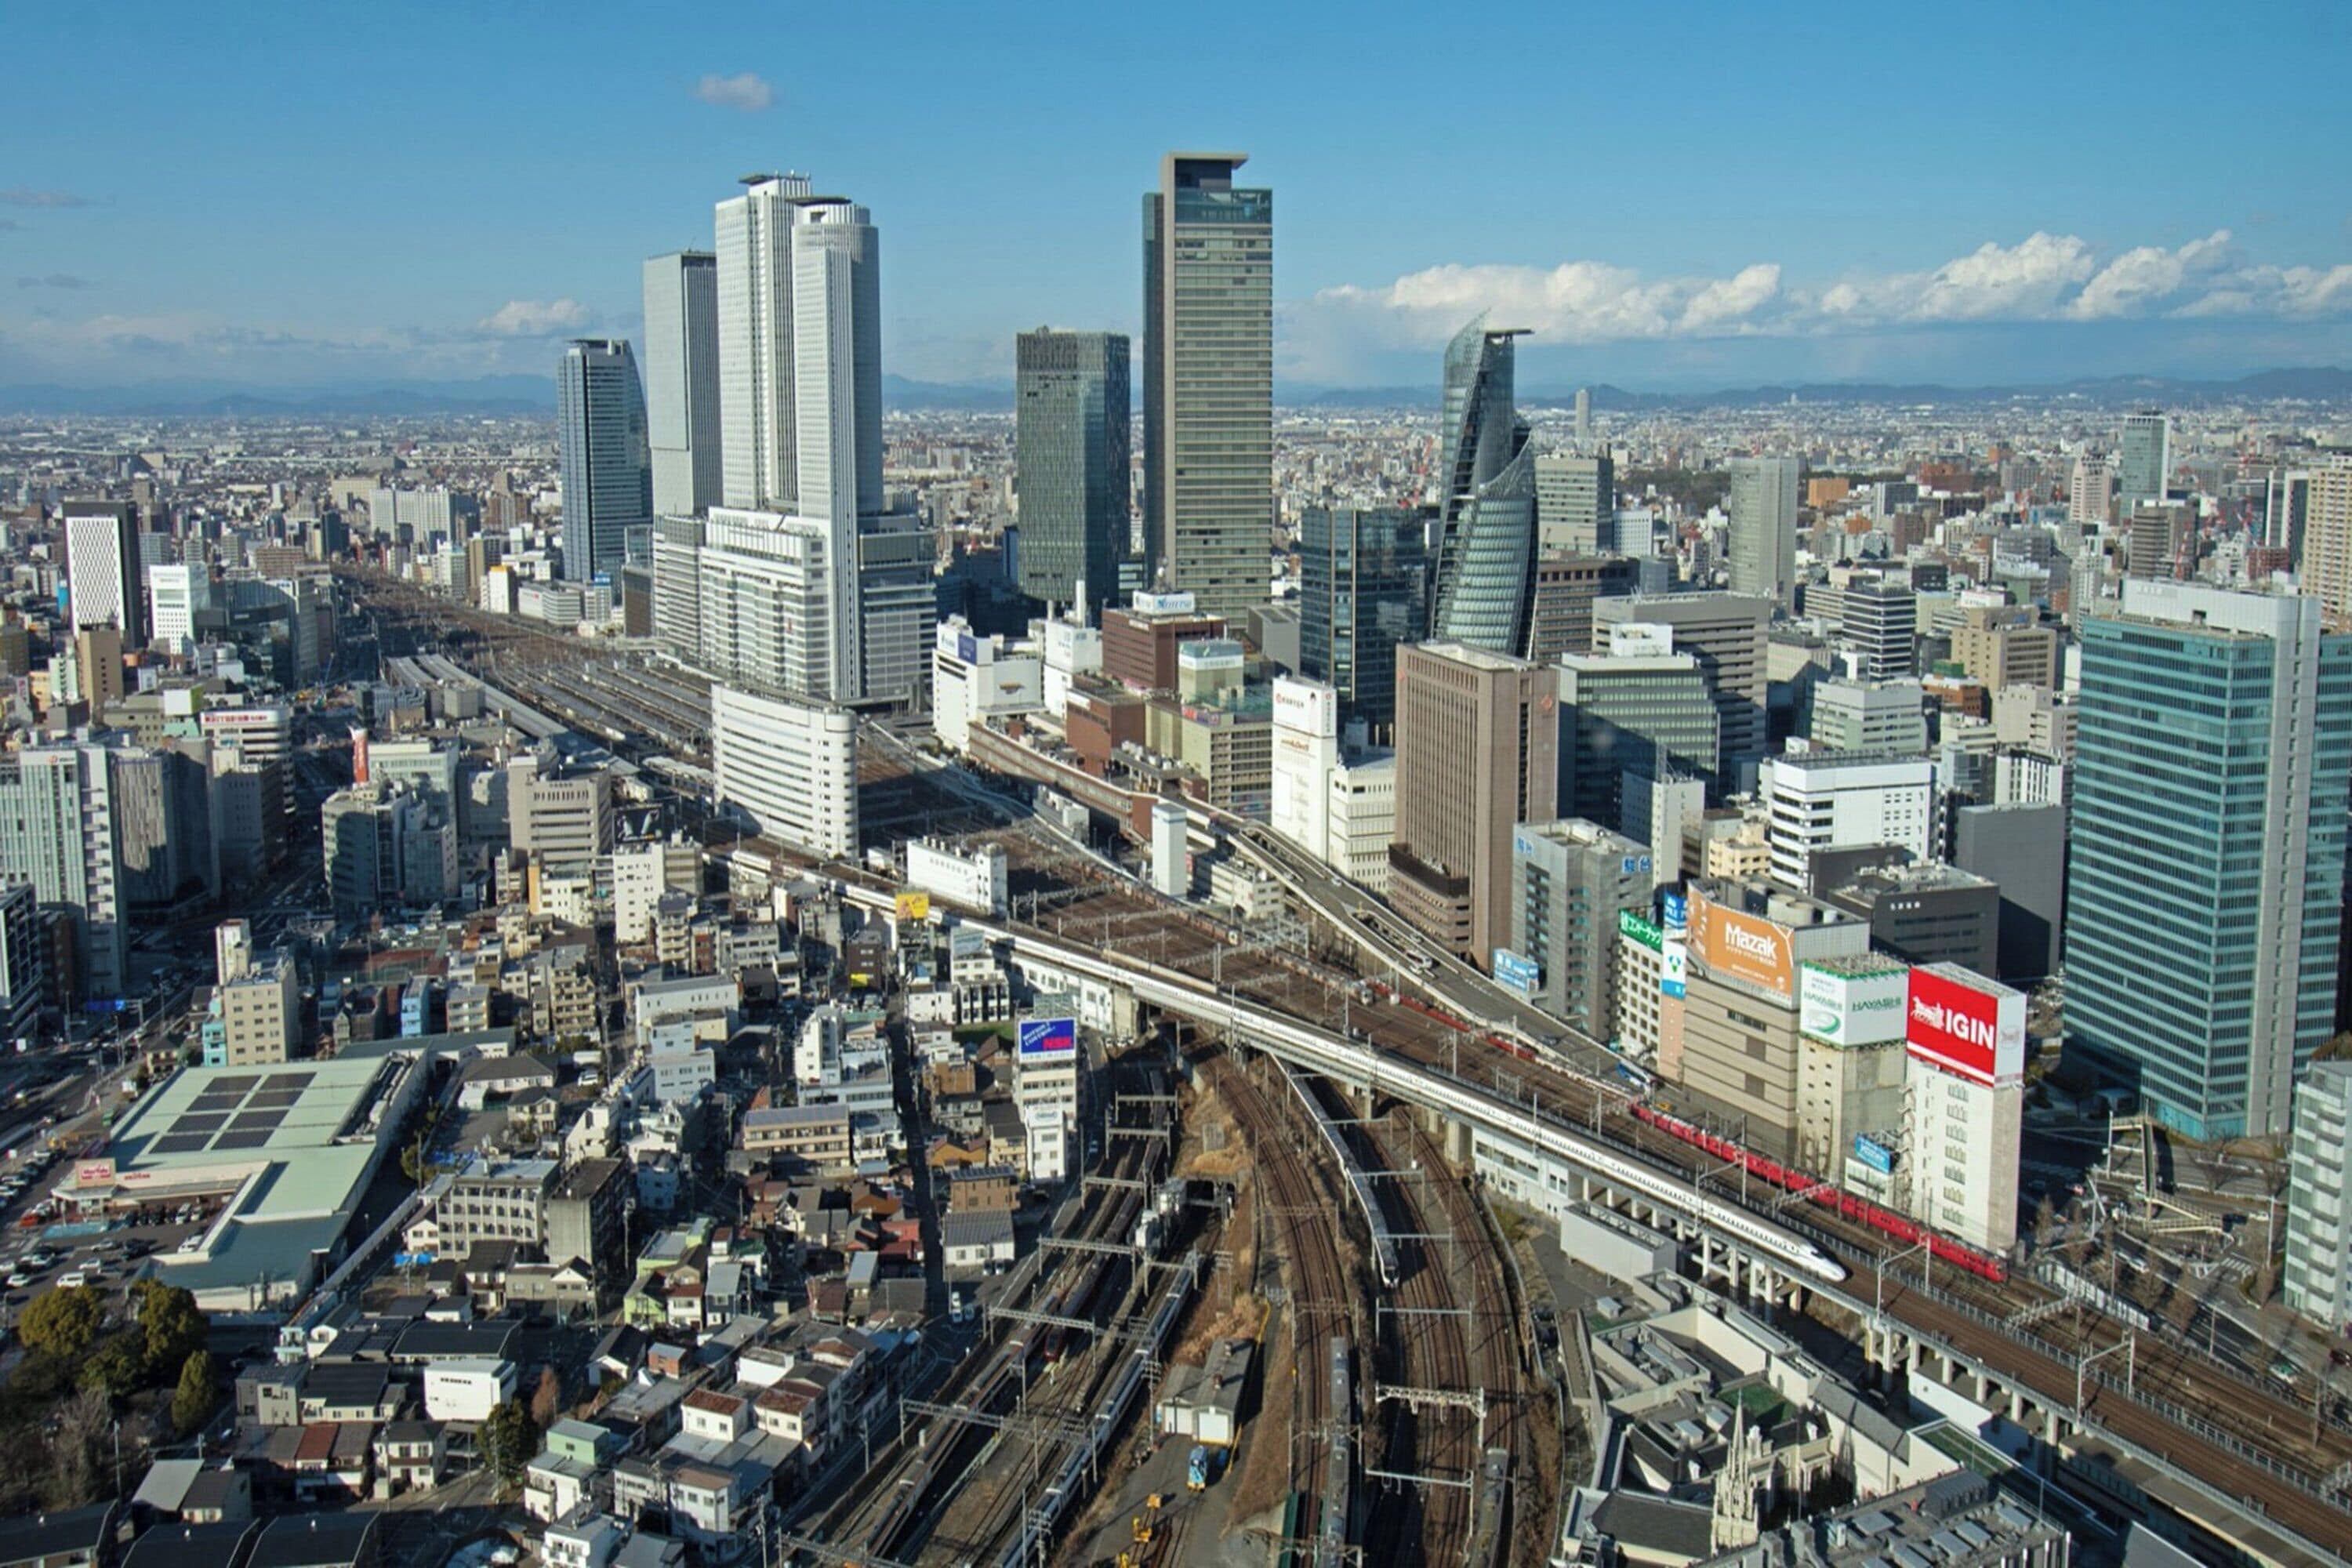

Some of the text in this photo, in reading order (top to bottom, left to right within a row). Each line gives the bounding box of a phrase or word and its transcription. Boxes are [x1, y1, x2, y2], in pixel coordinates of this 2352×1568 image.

[1725, 921, 1777, 960] Mazak
[1851, 996, 1903, 1012] HAYASHI
[1945, 1008, 1995, 1051] IGIN
